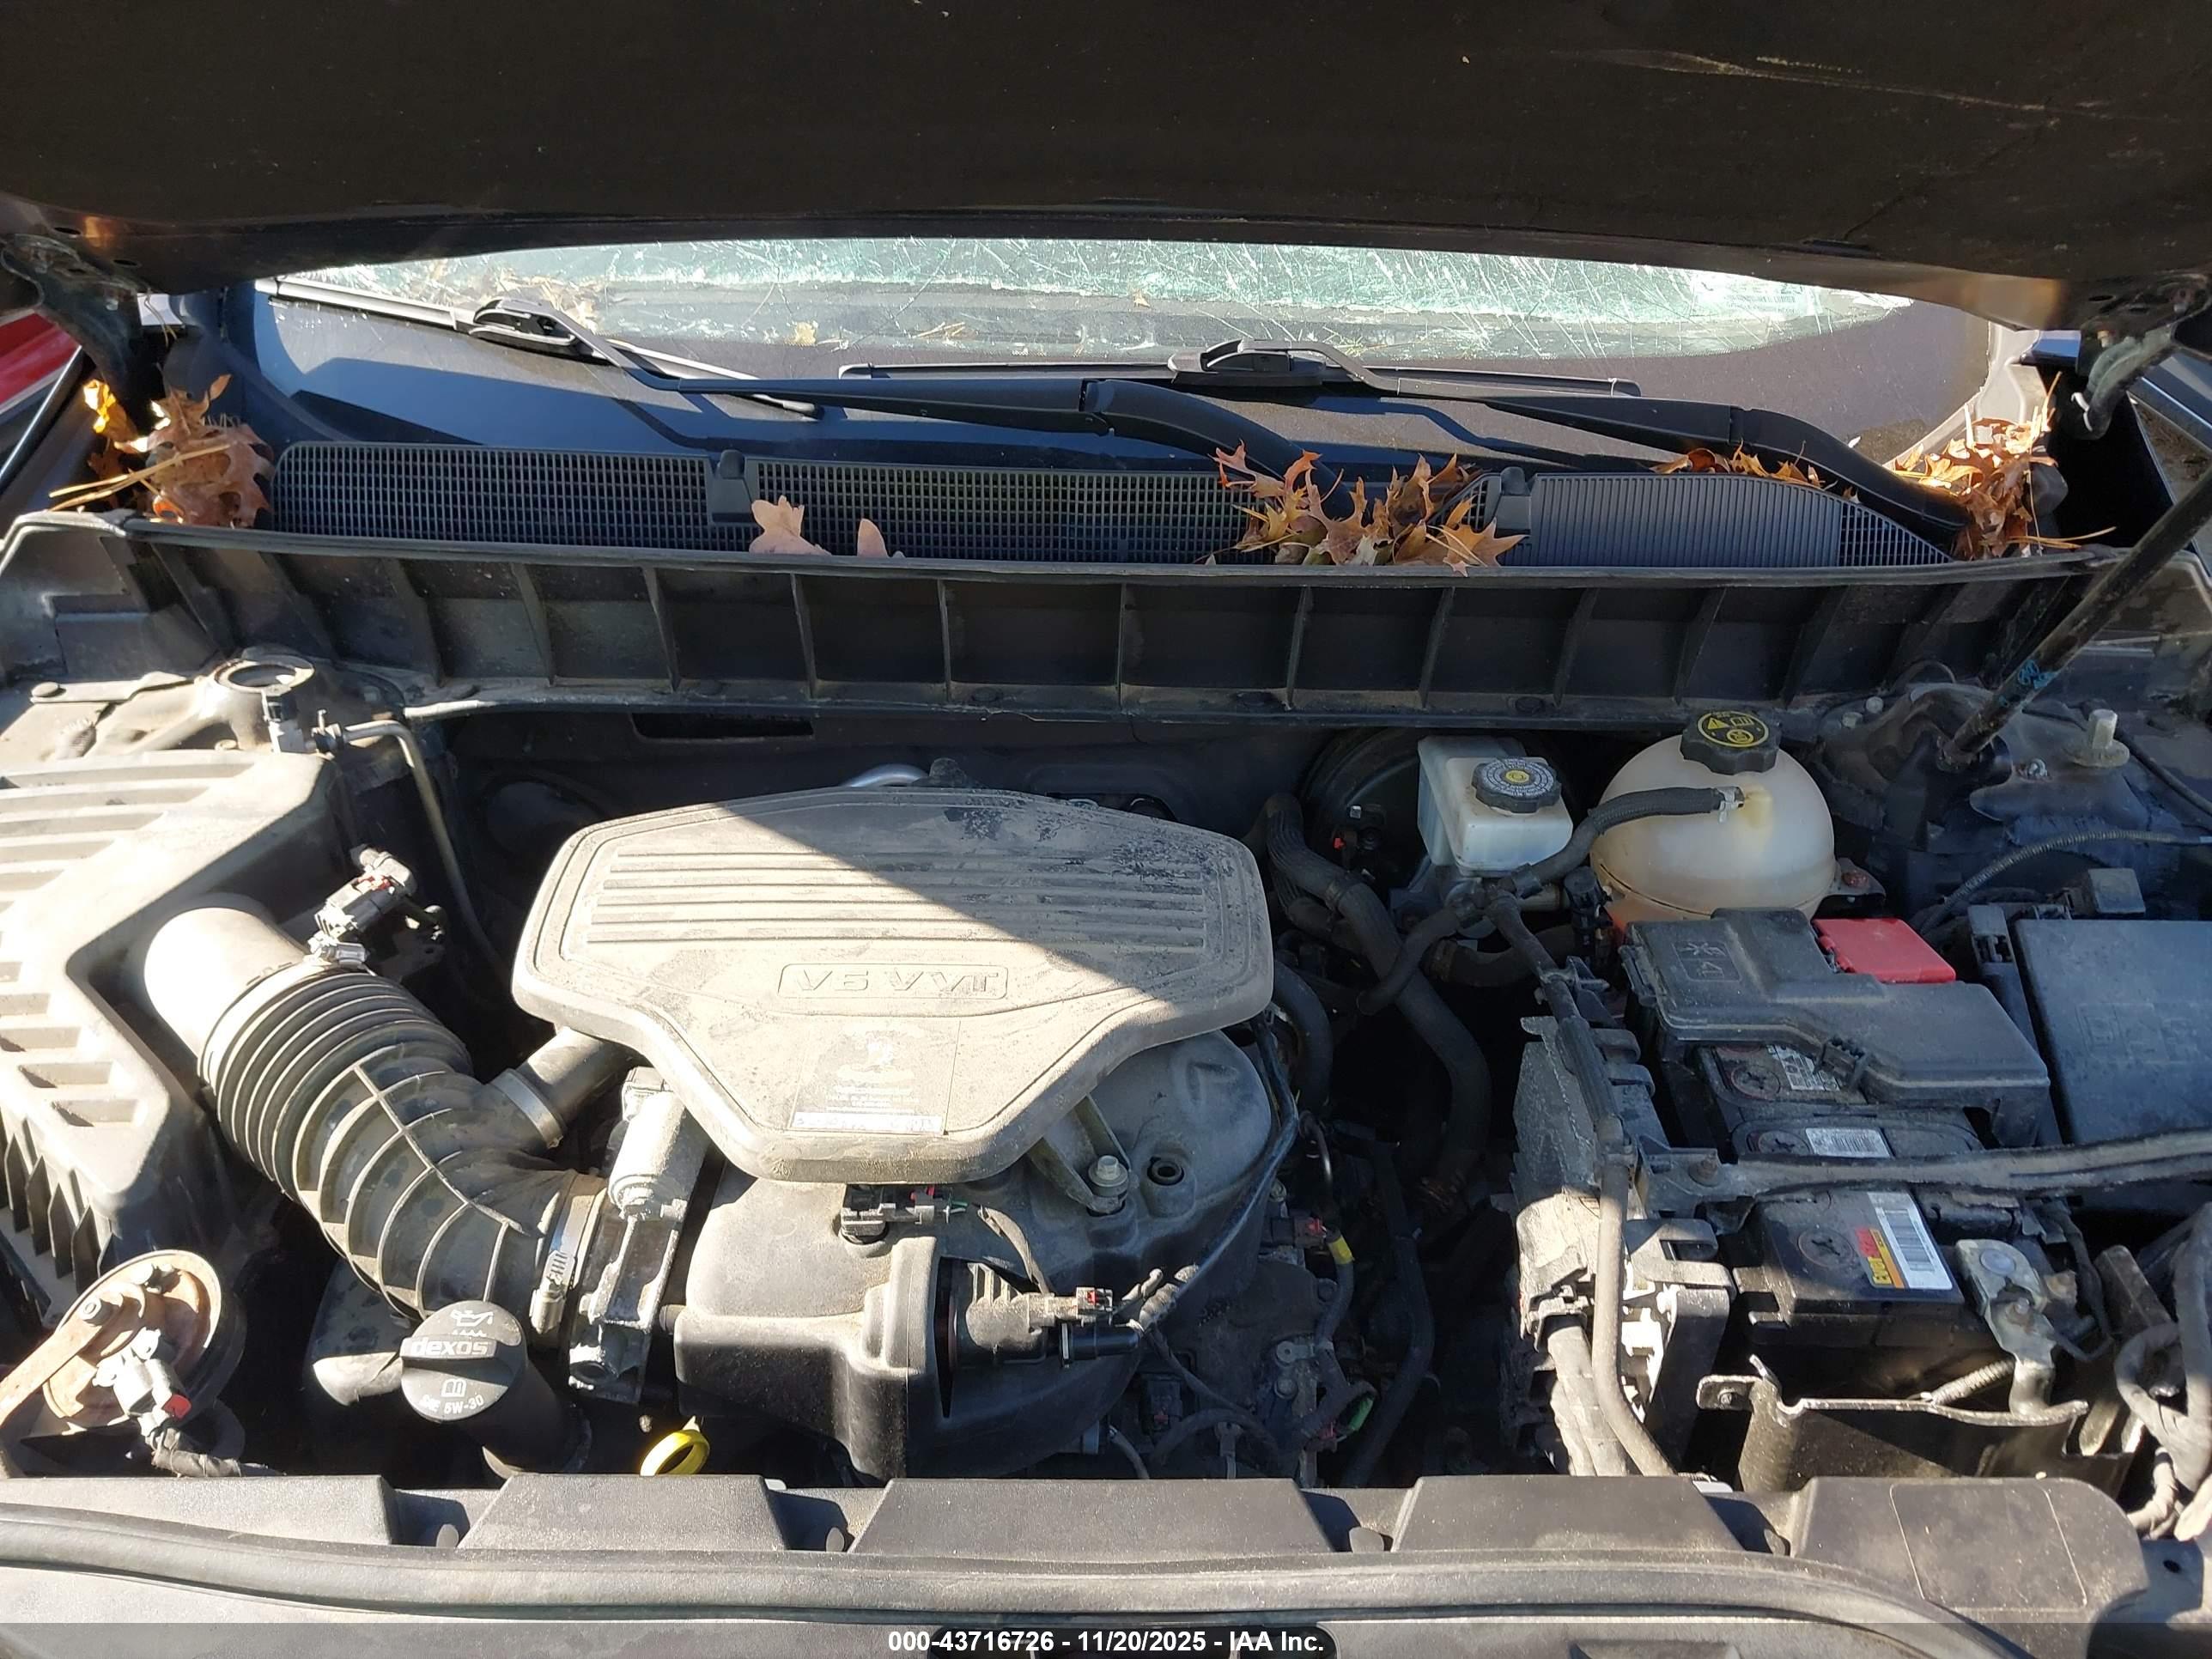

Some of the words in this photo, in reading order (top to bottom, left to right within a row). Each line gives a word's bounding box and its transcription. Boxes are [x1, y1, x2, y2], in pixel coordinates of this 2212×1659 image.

[795, 969, 869, 992] V6
[888, 969, 999, 993] VVT
[410, 1336, 489, 1356] dexos
[443, 1395, 484, 1414] 5W-30
